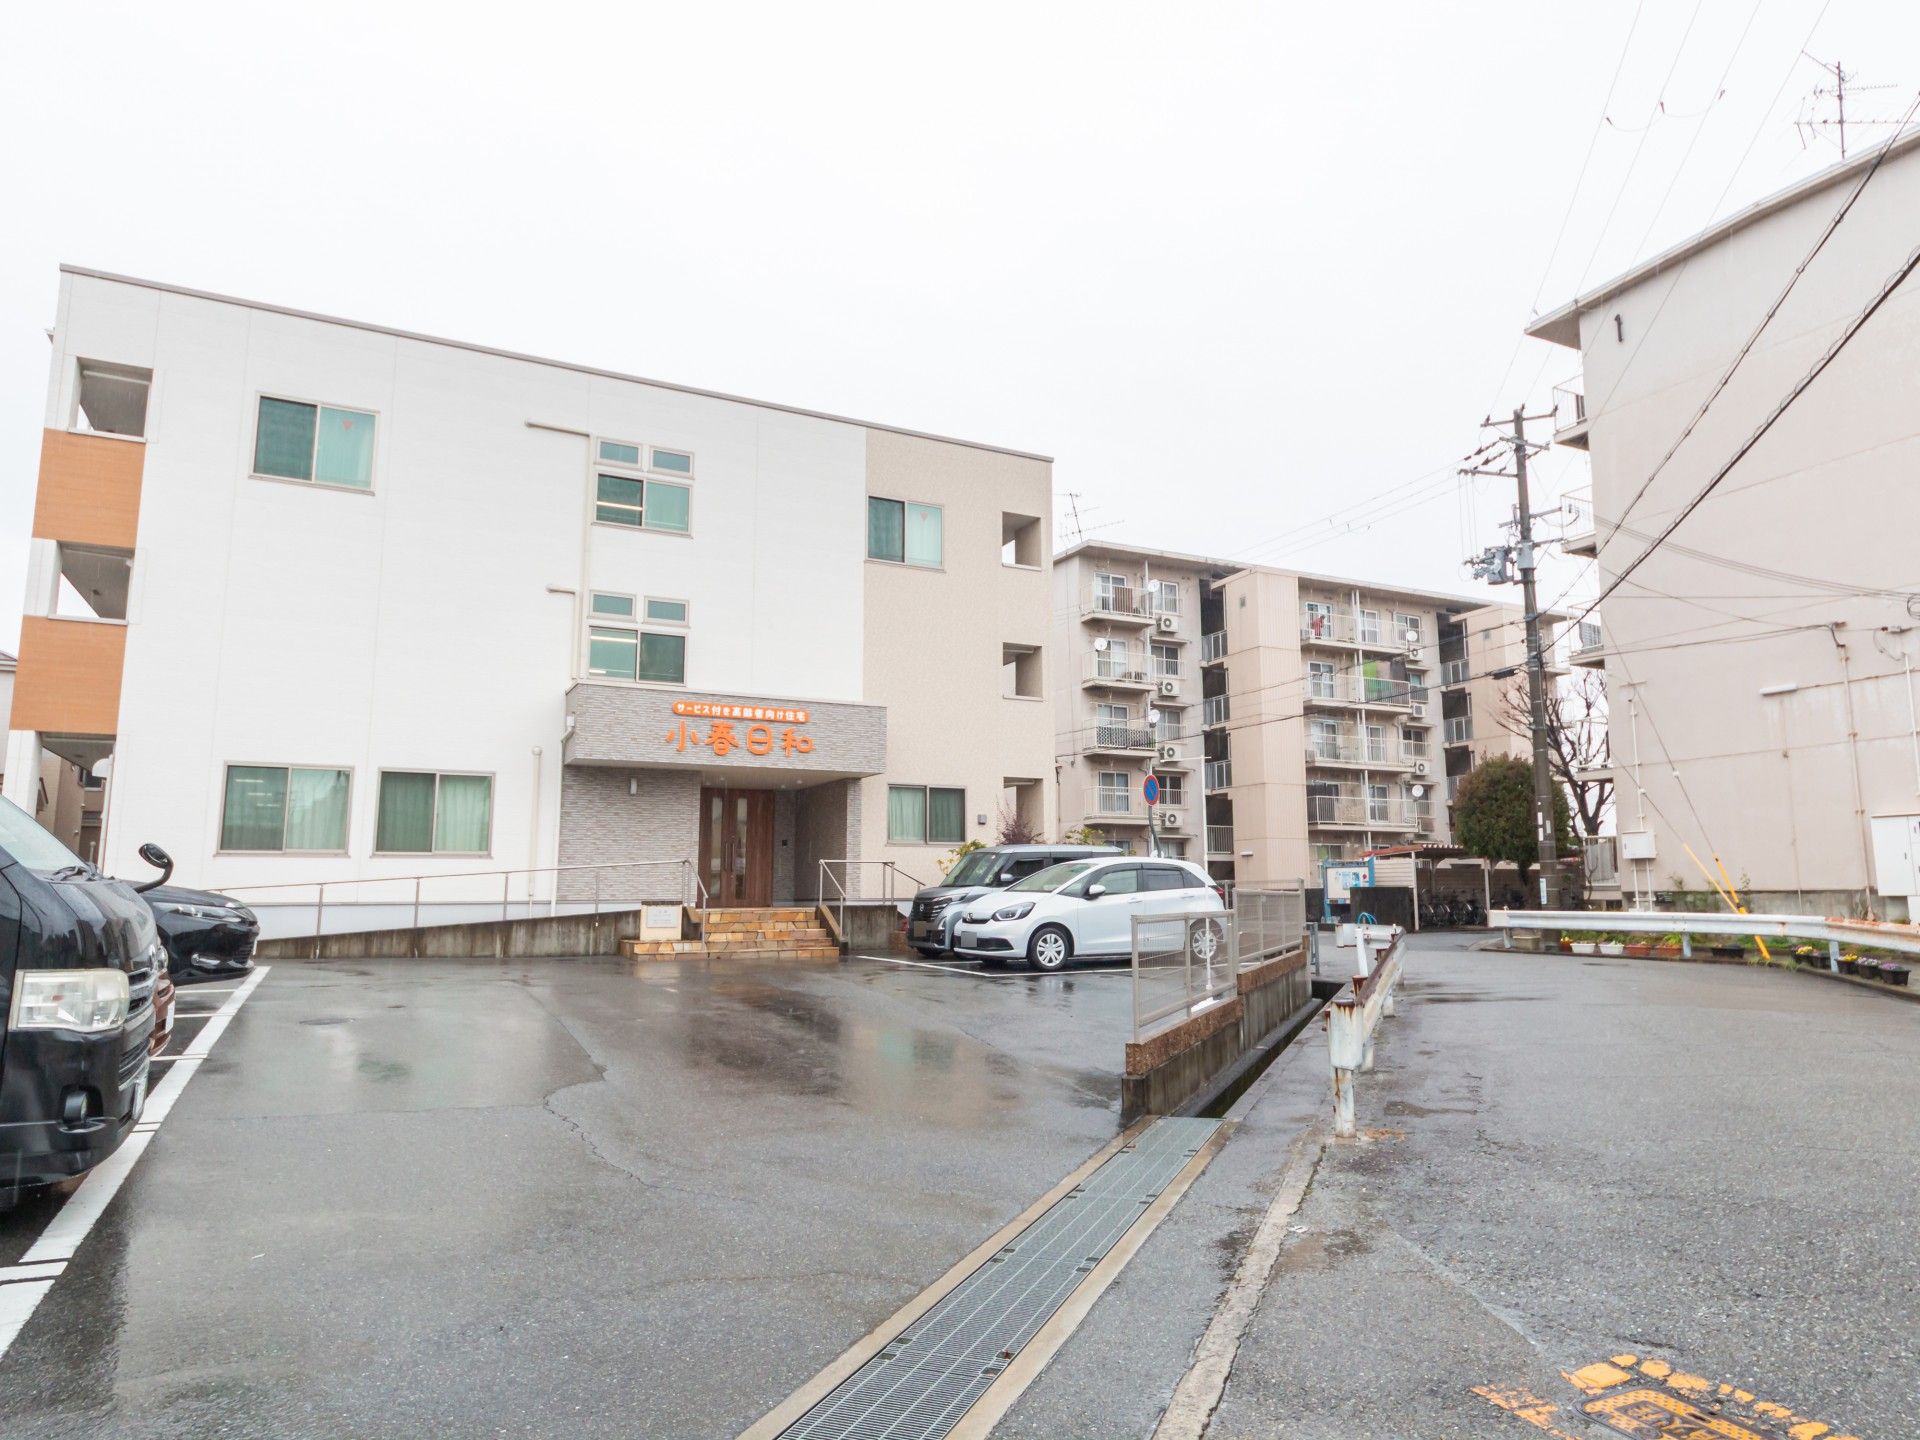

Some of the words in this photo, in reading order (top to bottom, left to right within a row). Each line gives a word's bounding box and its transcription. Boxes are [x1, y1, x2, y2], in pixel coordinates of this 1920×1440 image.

[677, 703, 806, 721] サービス付き高齢者向け住宅
[666, 720, 815, 757] 小春日和
